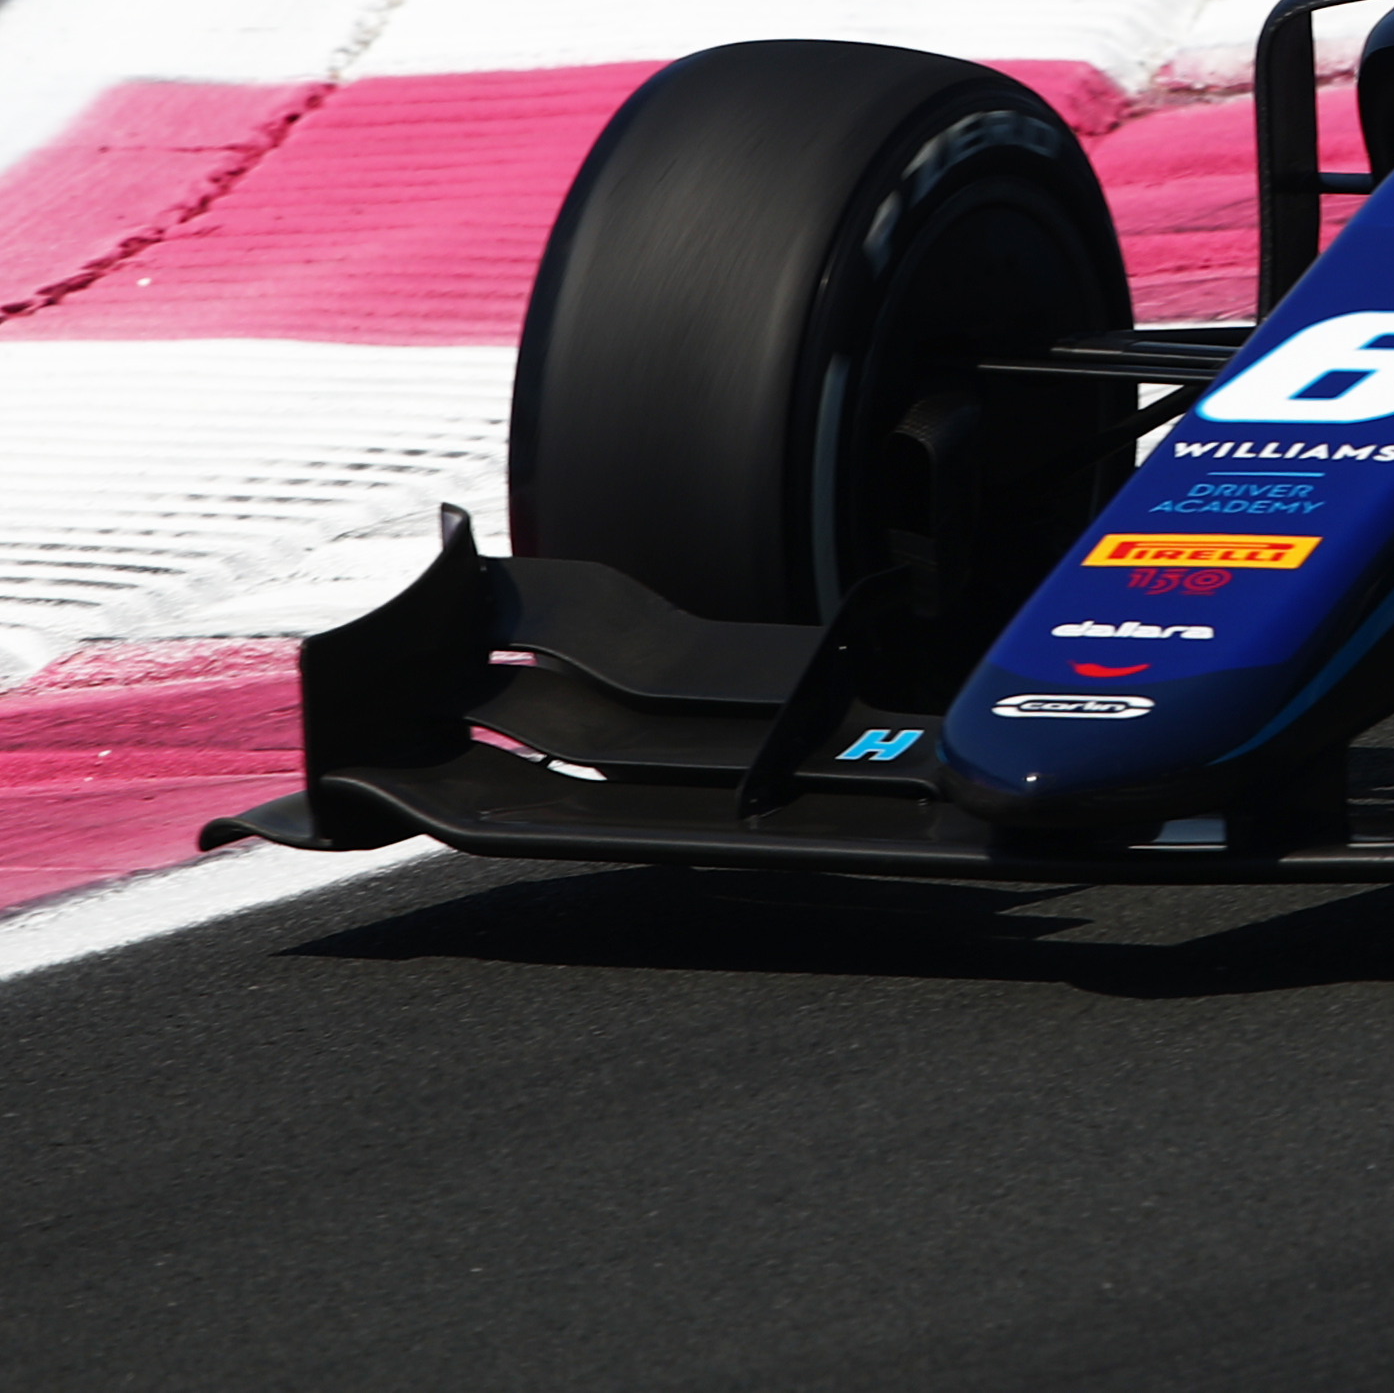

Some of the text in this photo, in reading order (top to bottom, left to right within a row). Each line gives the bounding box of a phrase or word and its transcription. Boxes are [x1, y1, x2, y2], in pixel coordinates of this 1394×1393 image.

[1188, 483, 1315, 498] DRIVER
[1149, 498, 1326, 515] ACADEMY
[1108, 540, 1294, 562] PIRELLI
[1051, 621, 1214, 640] dallara
